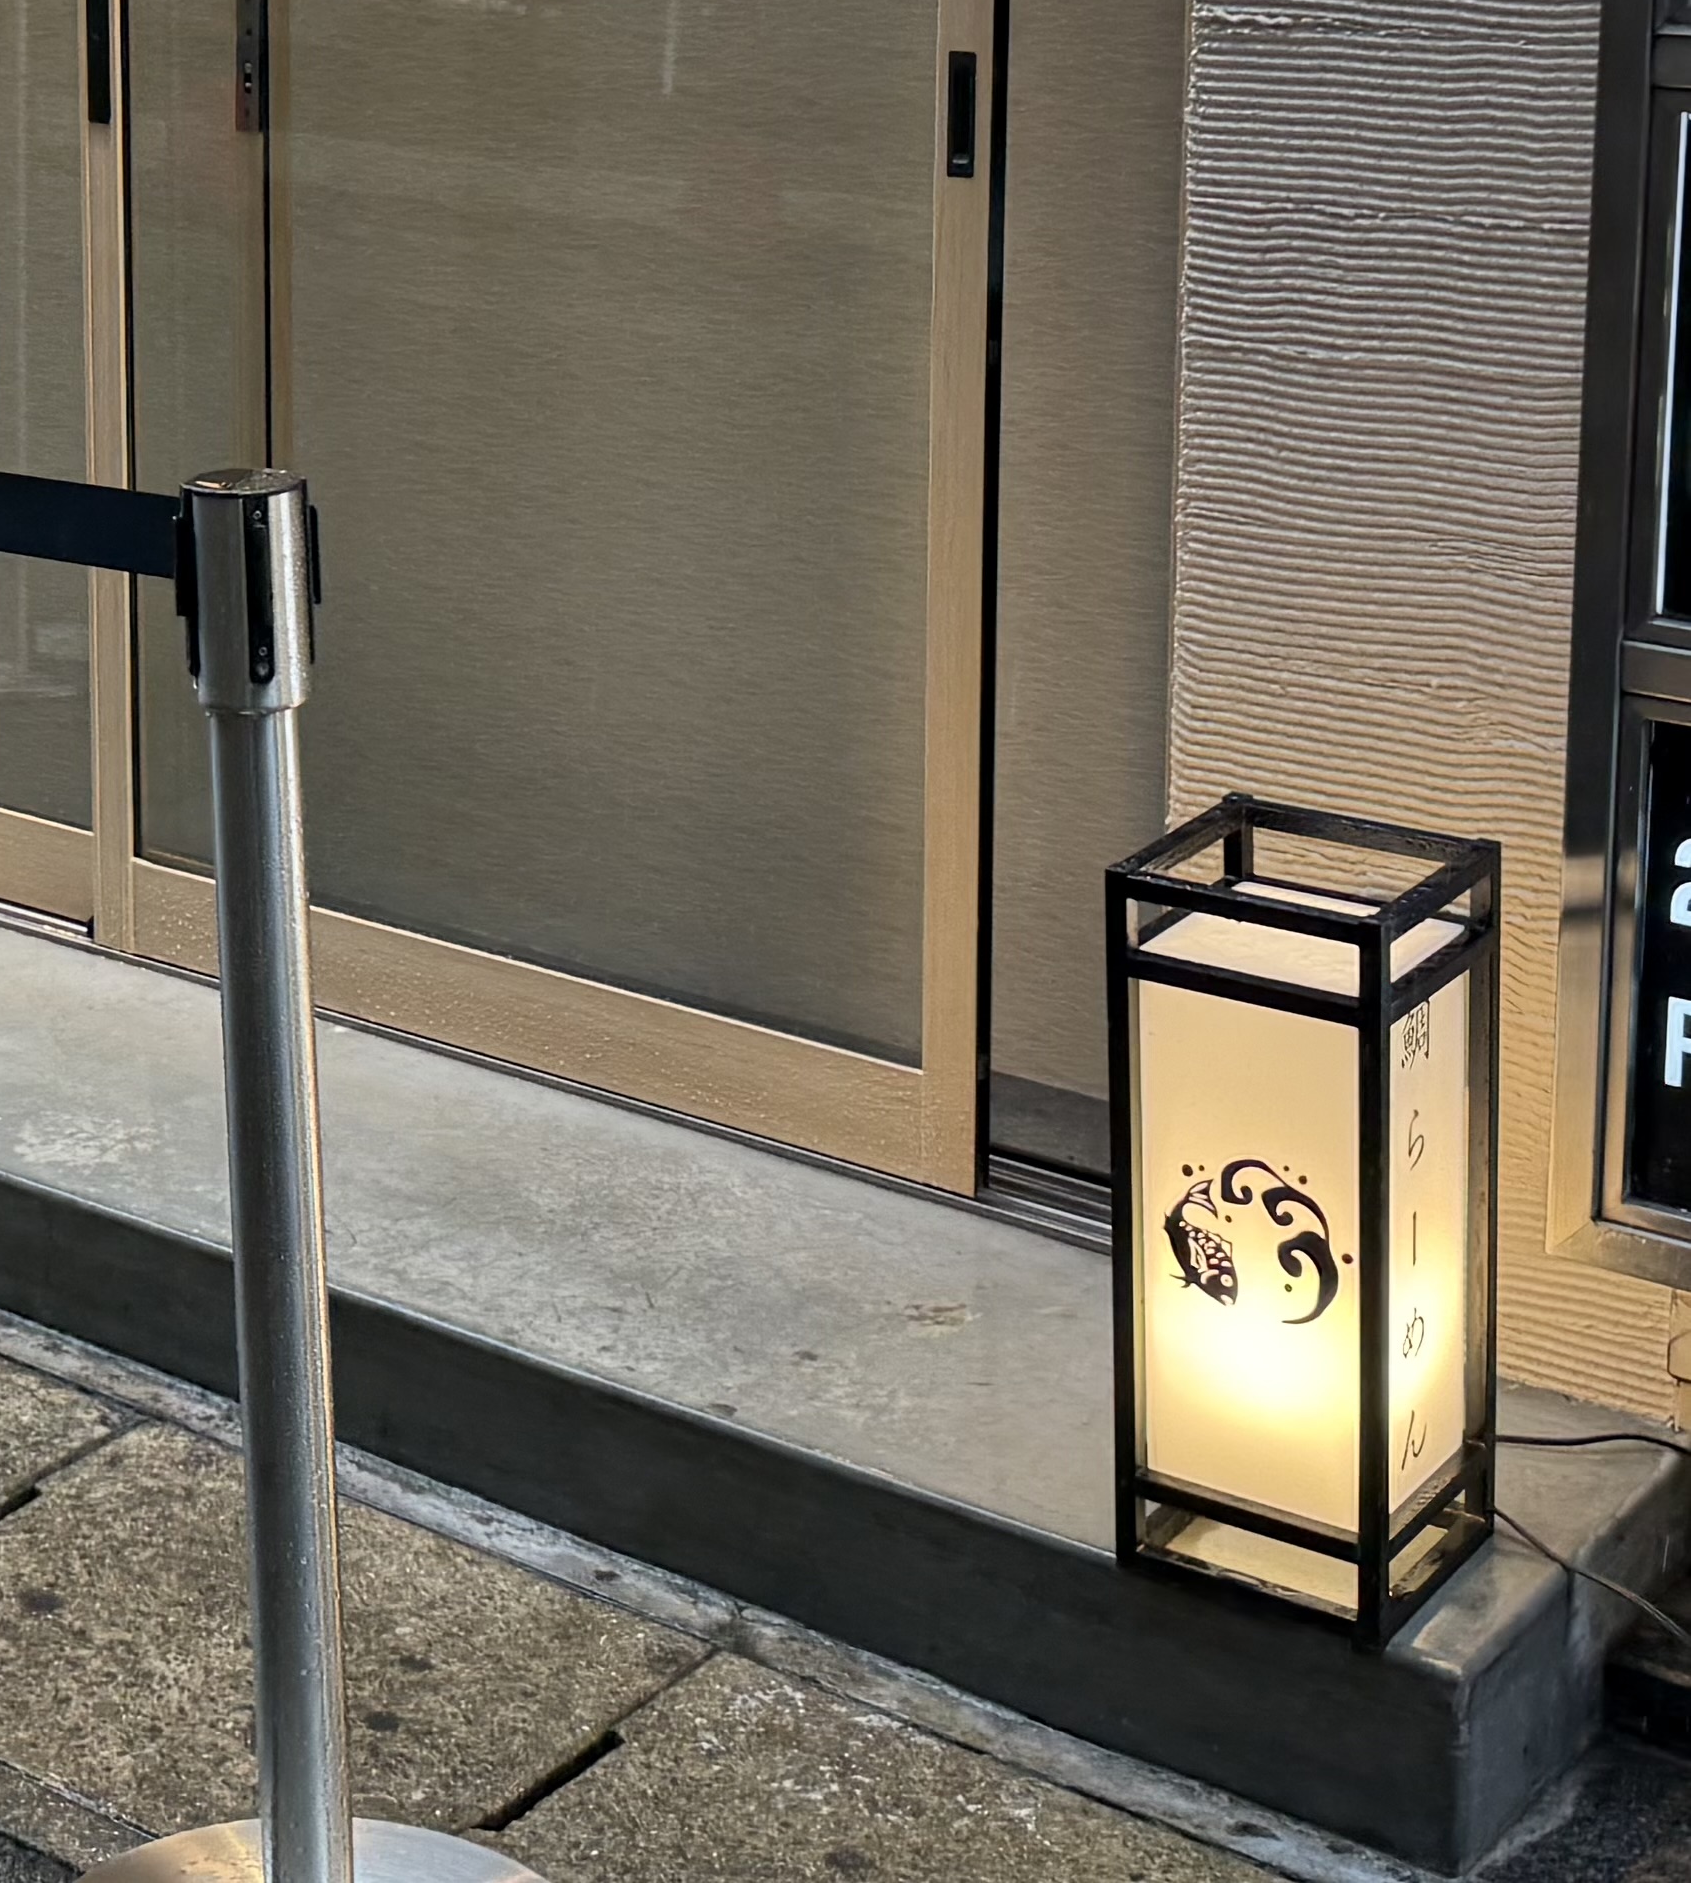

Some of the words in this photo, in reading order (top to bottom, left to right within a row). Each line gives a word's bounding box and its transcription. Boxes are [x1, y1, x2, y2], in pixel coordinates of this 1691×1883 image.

[1401, 1000, 1431, 1471] 鯛らーめん
